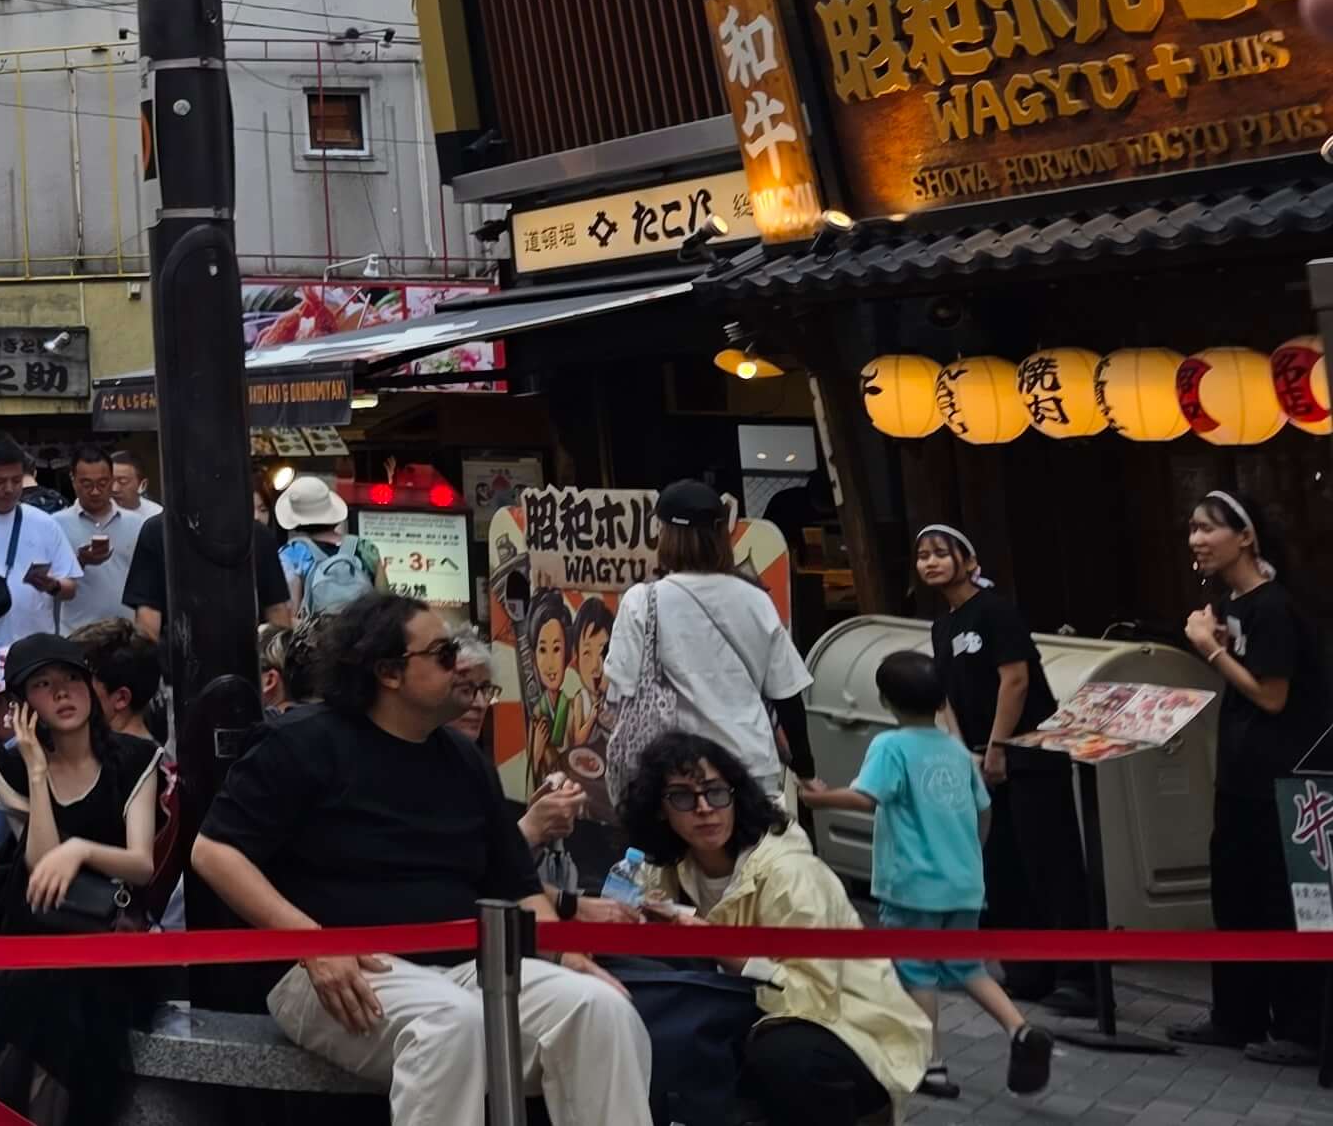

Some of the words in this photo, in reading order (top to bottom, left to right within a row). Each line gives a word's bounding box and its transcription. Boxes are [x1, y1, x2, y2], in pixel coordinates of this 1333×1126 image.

[718, 4, 798, 180] 和牛
[923, 53, 1136, 144] WAGYU
[1199, 29, 1291, 83] PLUS
[911, 160, 996, 202] SHOWA
[1005, 136, 1116, 186] HORMON
[1121, 119, 1229, 168] WAGYU
[1237, 102, 1328, 153] PLUS
[1019, 356, 1069, 425] 焼肉
[523, 491, 659, 552] 昭和ホル
[563, 555, 646, 585] WAGYU
[1292, 779, 1333, 871] 牛
